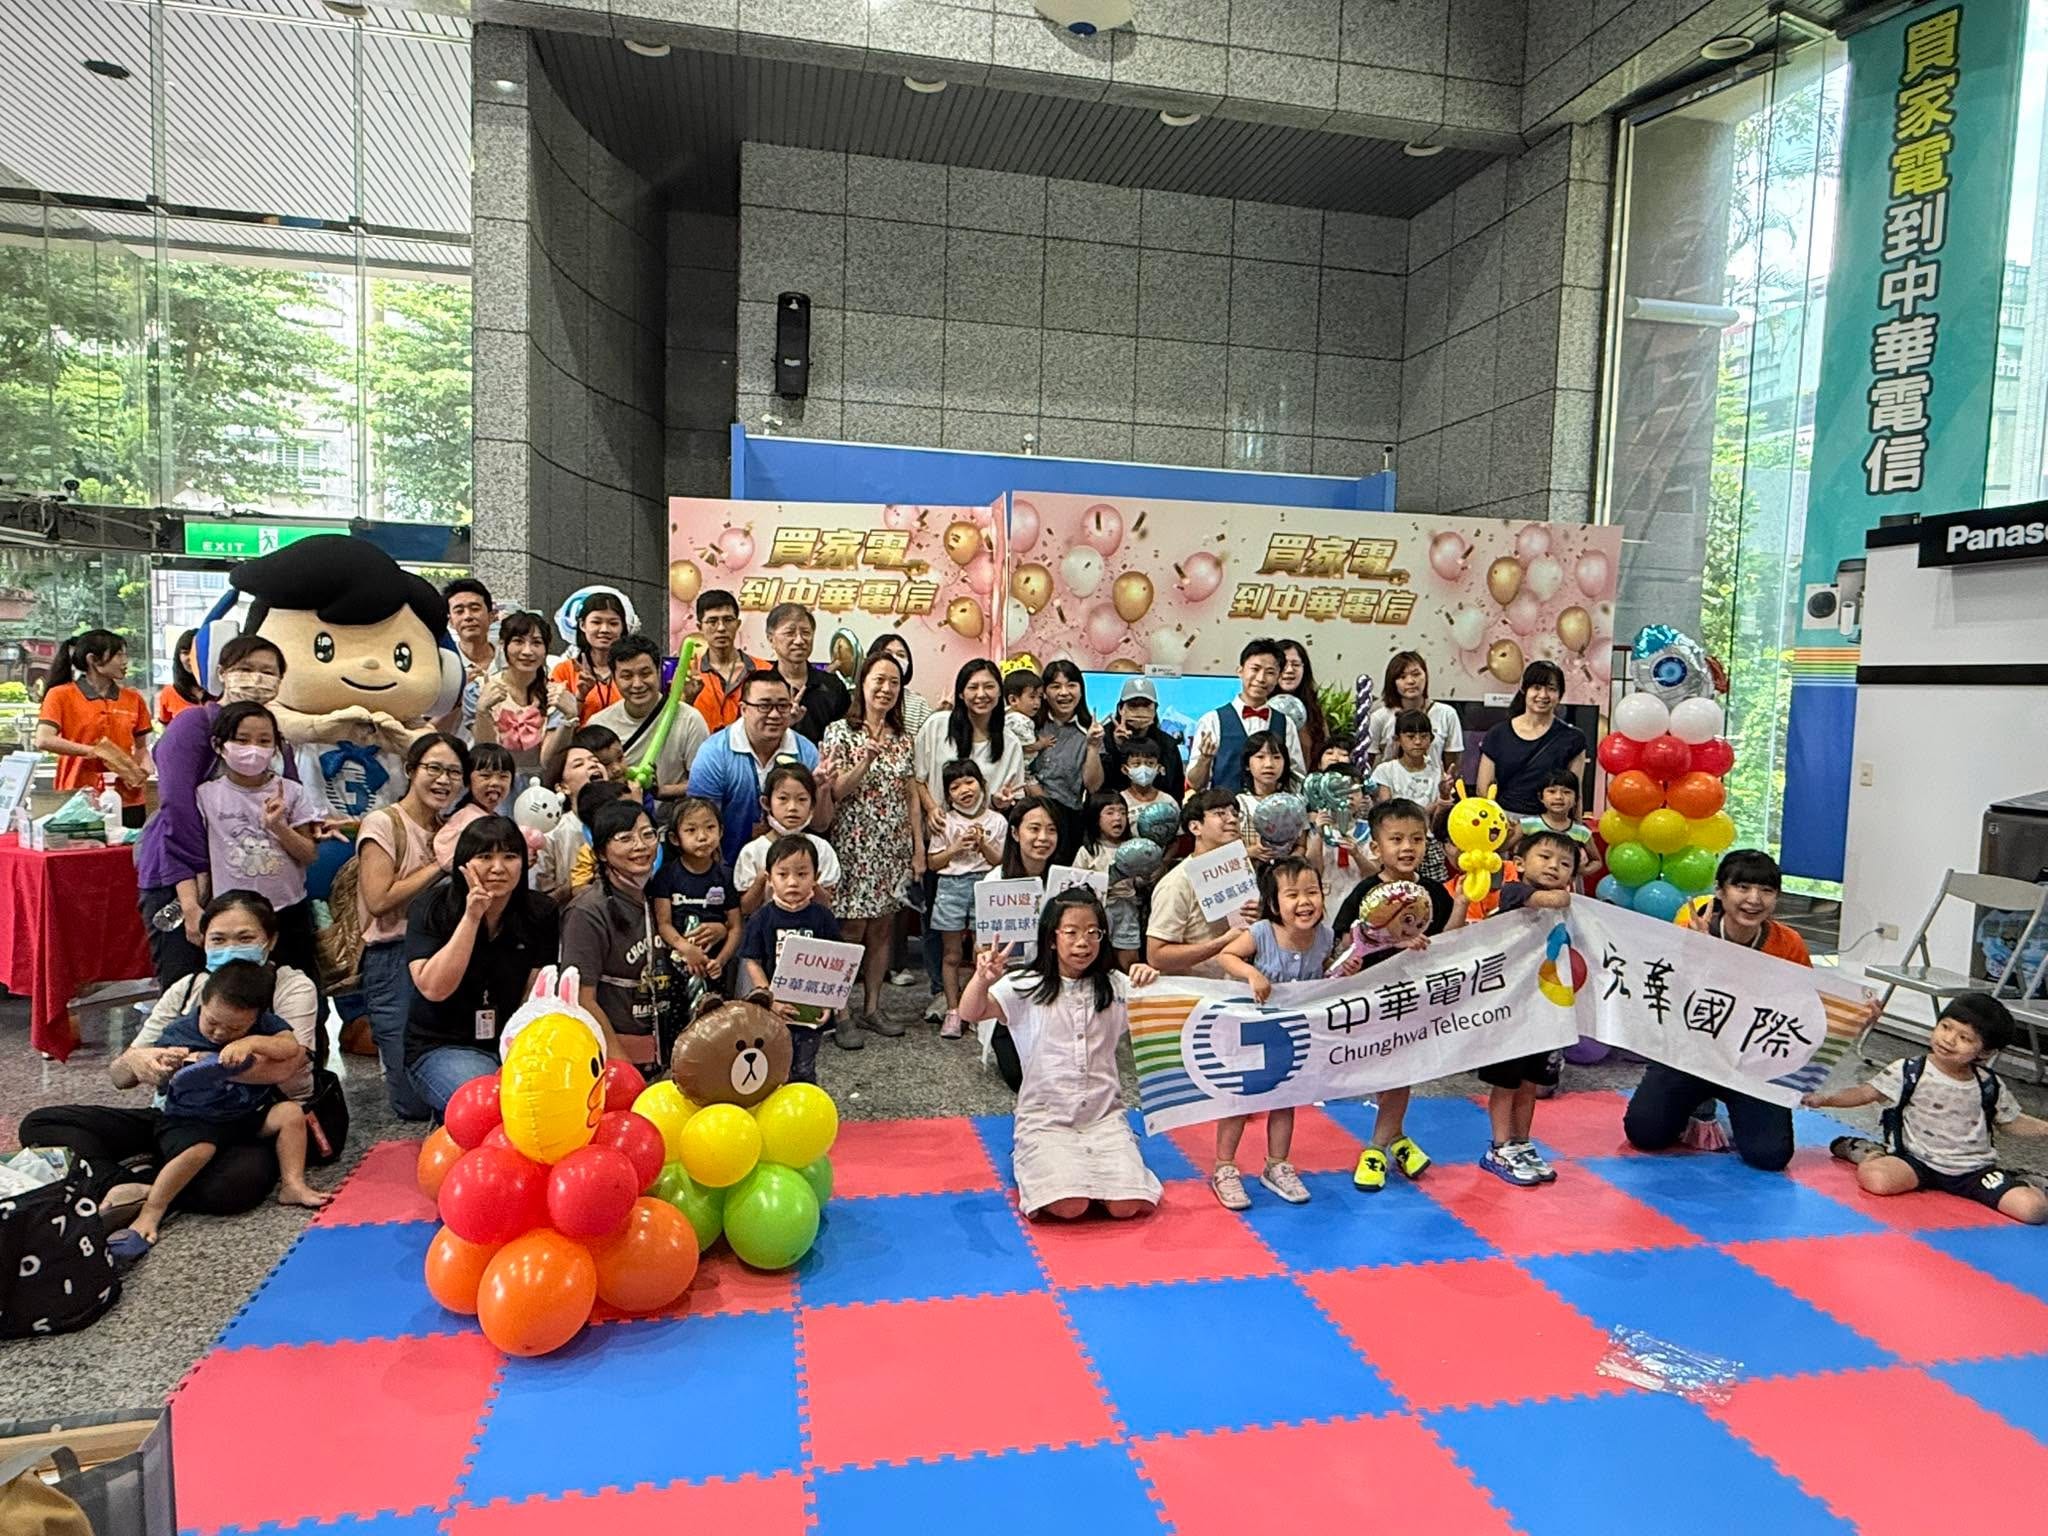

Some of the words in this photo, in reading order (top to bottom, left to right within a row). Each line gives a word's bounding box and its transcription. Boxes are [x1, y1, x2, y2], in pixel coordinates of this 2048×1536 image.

[1864, 6, 1962, 492] 買家電到中華電信
[202, 541, 245, 553] EXIT
[763, 527, 928, 572] 買家電
[1256, 533, 1409, 582] 買家電
[1946, 522, 2048, 553] Panas
[739, 577, 939, 614] 到中華電信
[1228, 583, 1417, 625] 到中華電信
[1327, 952, 1507, 1034] 中華電信
[1329, 1025, 1428, 1065] Chunghwa
[1430, 1003, 1512, 1036] Telecom
